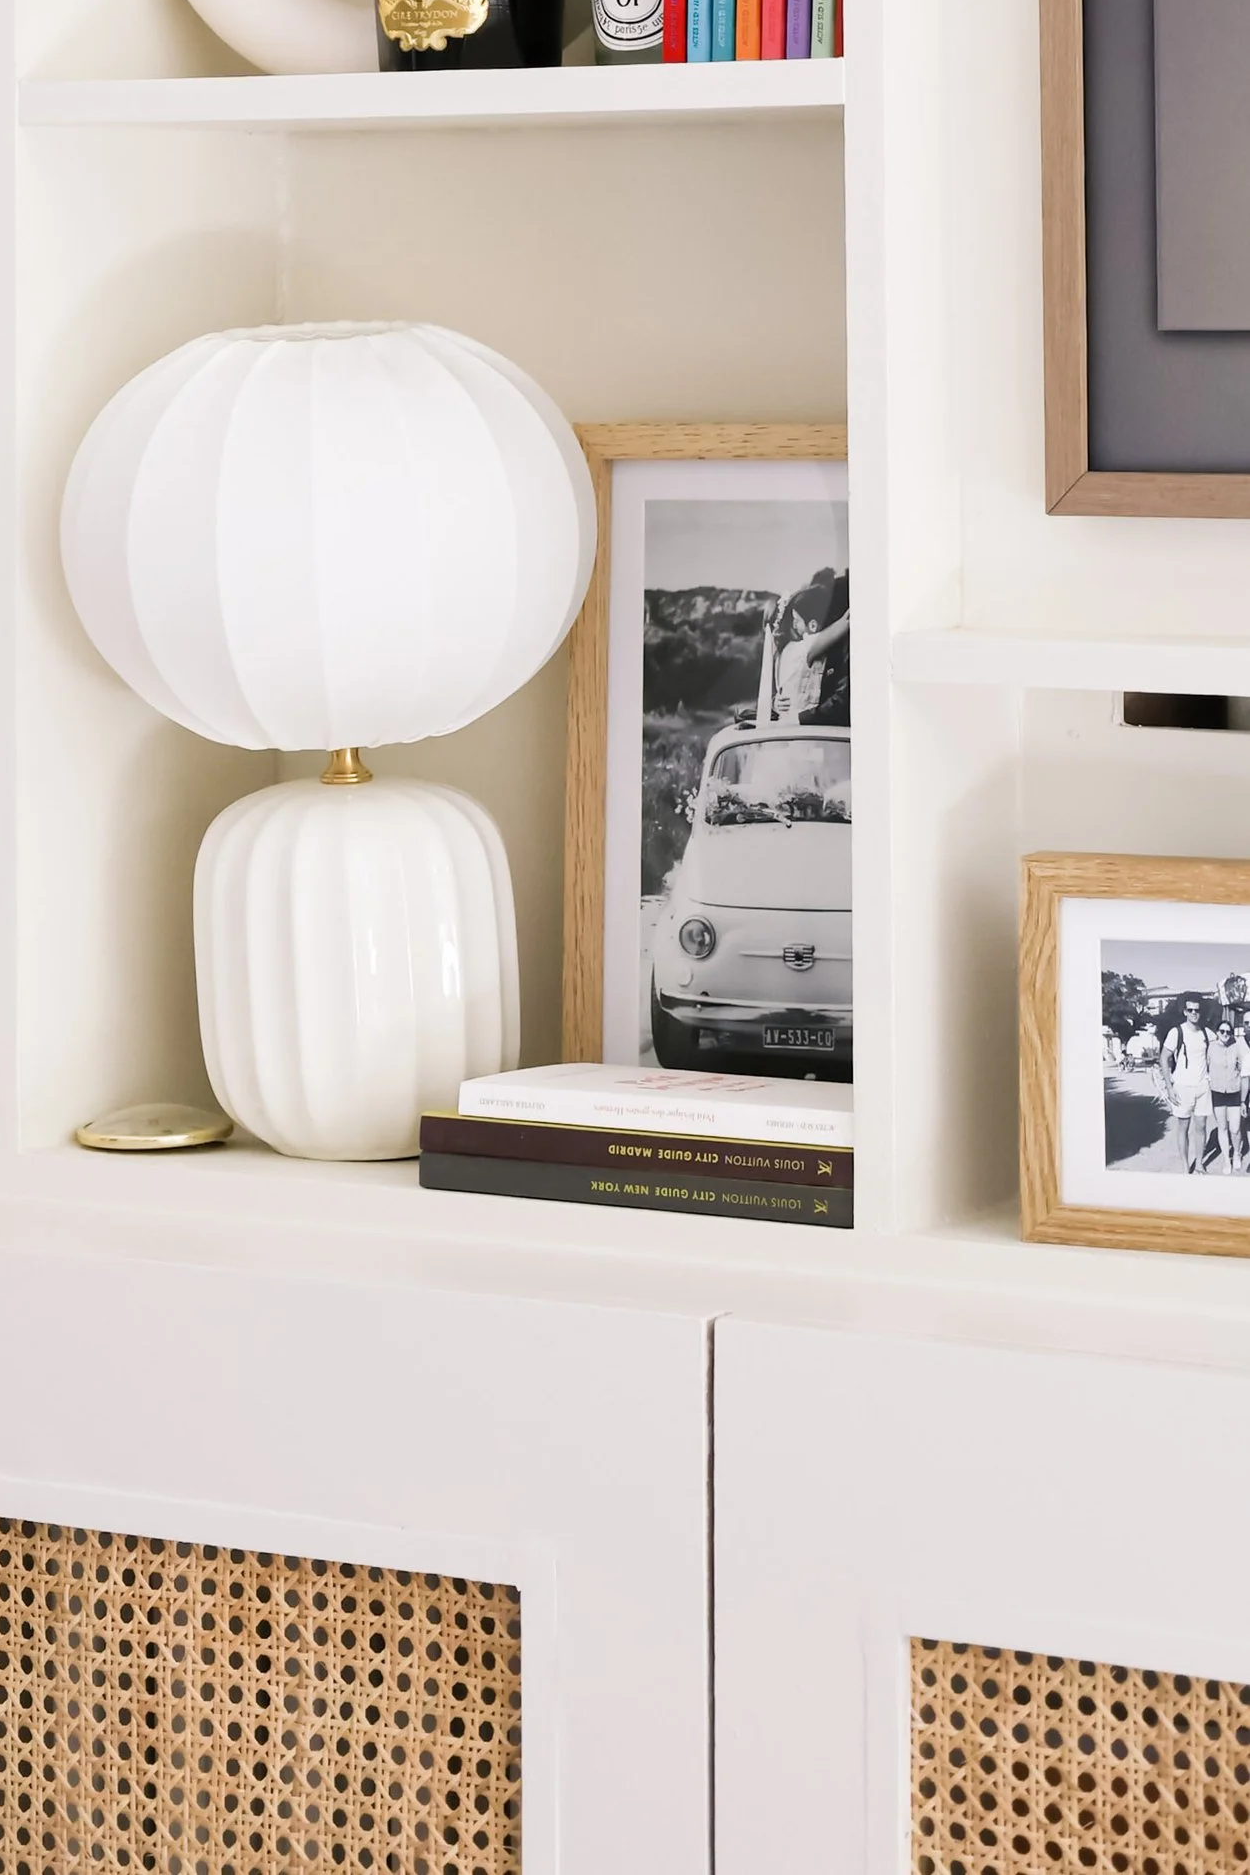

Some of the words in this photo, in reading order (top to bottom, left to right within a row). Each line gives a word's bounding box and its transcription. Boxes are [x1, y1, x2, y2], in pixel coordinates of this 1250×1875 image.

[608, 1144, 652, 1157] MADRID
[657, 1149, 693, 1162] GUIDE
[694, 1152, 719, 1163] CITY
[724, 1155, 771, 1168] VUITTON
[774, 1158, 805, 1171] LOUIS
[590, 1180, 620, 1192] YORK
[622, 1183, 649, 1195] NEW
[654, 1186, 689, 1199] GUIDE
[691, 1190, 716, 1202] CITY
[721, 1193, 768, 1206] VUITTON
[770, 1197, 802, 1209] LOUIS
